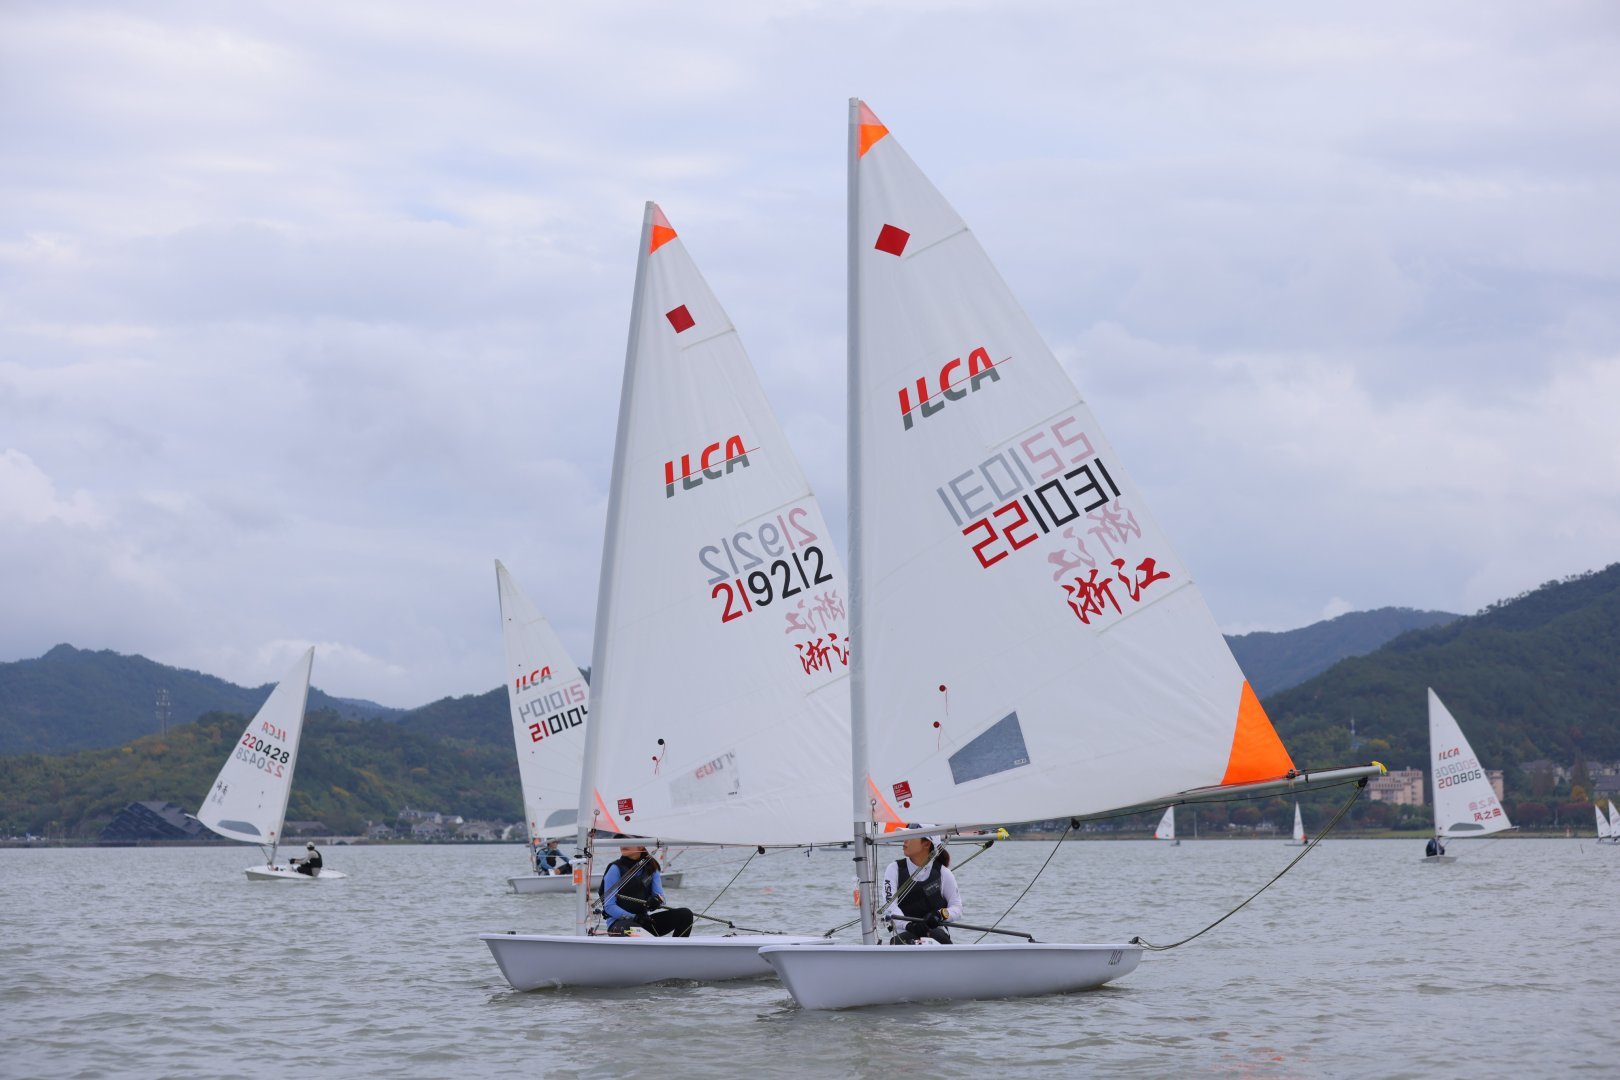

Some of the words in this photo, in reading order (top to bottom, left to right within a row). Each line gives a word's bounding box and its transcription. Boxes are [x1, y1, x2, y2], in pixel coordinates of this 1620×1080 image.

[898, 346, 1001, 431] ILCA
[664, 434, 751, 499] ILCA
[962, 458, 1121, 569] 221031
[711, 546, 833, 623] 219212
[1061, 557, 1171, 625] 浙江
[516, 666, 552, 694] ILCA
[242, 733, 290, 764] 220428
[1438, 747, 1460, 761] ILCA
[1438, 769, 1481, 789] 200806
